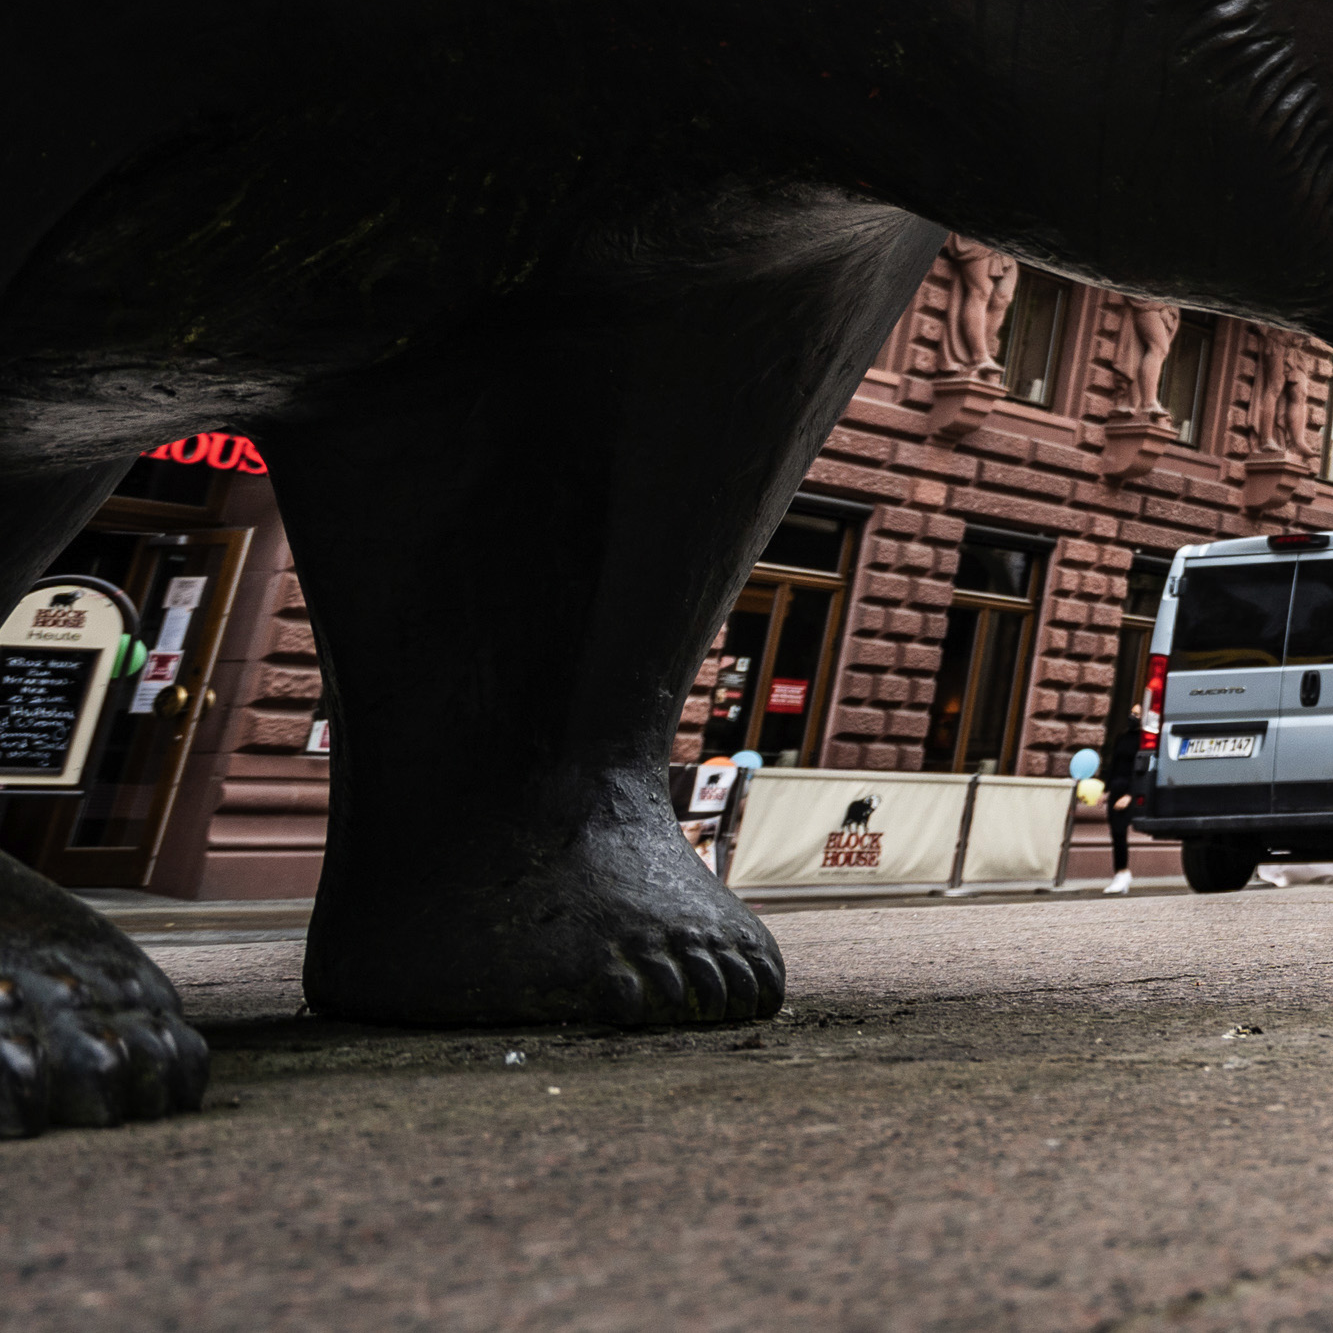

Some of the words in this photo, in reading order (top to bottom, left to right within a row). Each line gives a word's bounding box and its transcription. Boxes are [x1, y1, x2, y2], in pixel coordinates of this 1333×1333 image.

[31, 617, 86, 628] HOUSE
[26, 630, 81, 641] Heute
[1189, 687, 1246, 696] DUCATO
[1230, 738, 1251, 752] 147
[824, 832, 883, 850] BLOCK
[820, 850, 881, 867] HOUSE
